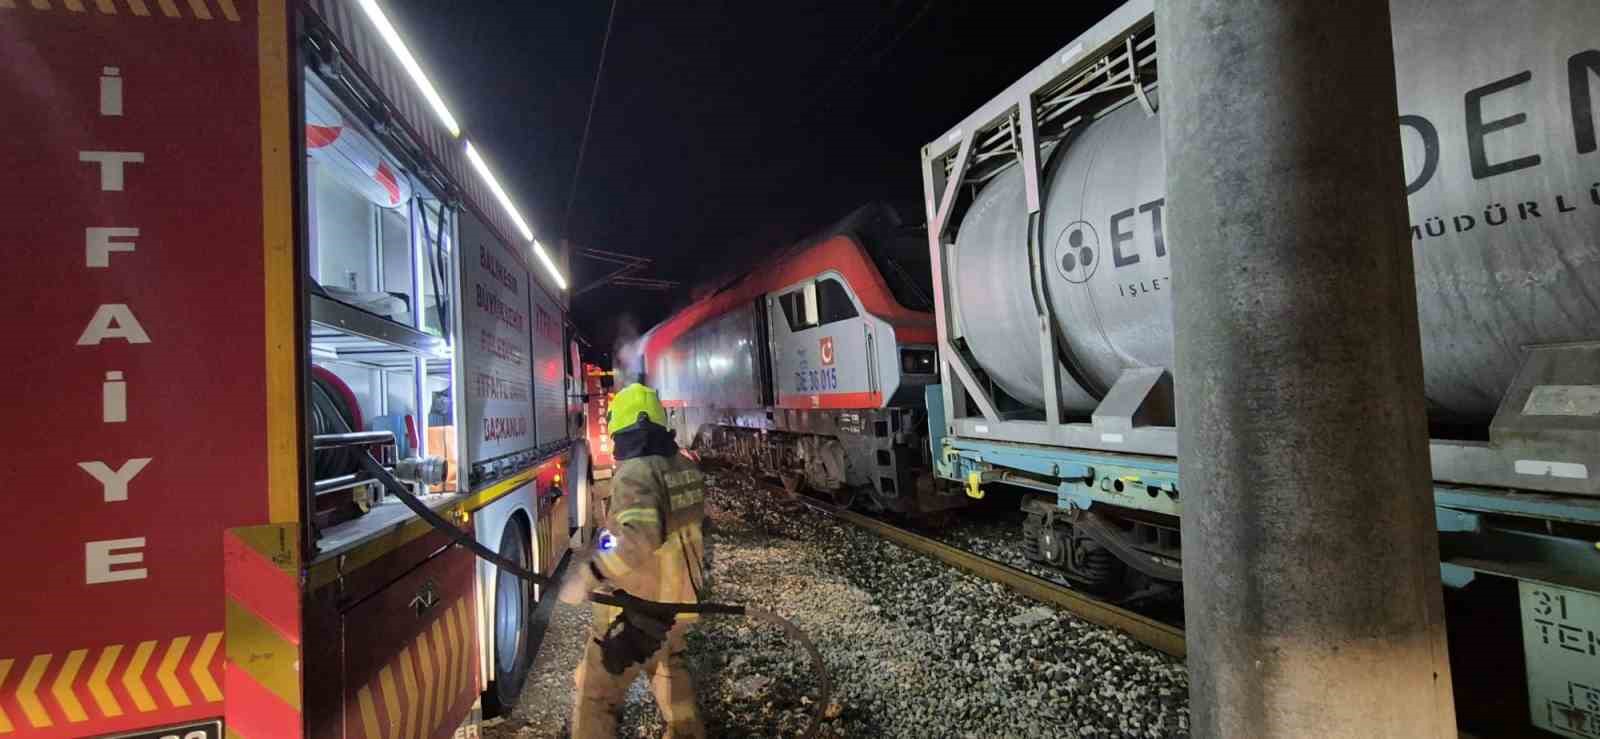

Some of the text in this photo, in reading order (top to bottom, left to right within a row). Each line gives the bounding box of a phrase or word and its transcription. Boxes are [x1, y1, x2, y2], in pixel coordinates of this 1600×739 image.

[1110, 198, 1166, 268] ET
[1117, 276, 1168, 297] İŞLE
[77, 66, 152, 585] İTFAİYE
[1533, 590, 1568, 620] 31
